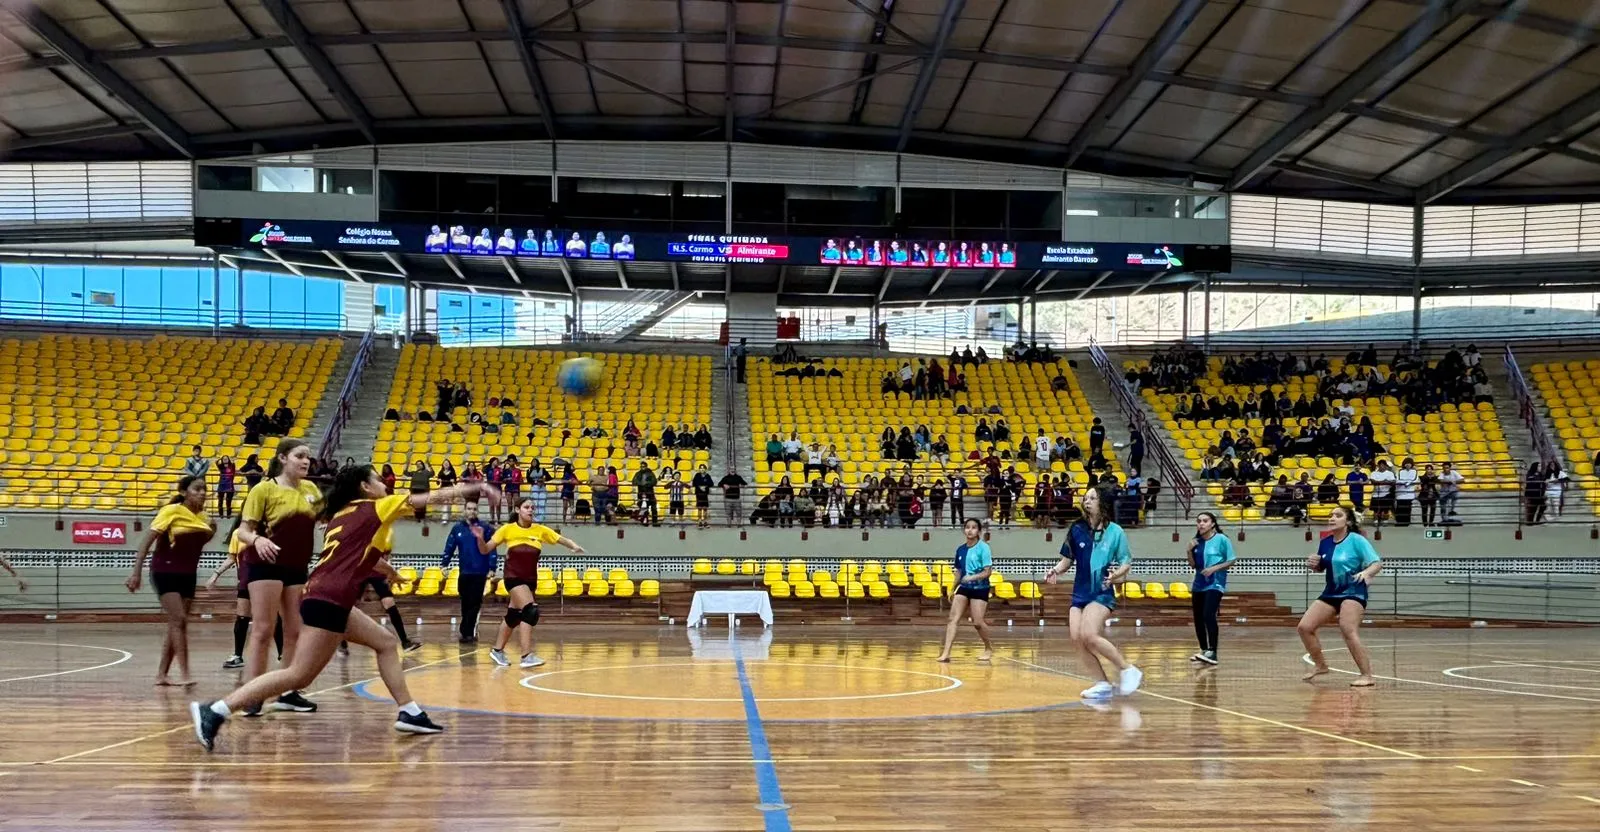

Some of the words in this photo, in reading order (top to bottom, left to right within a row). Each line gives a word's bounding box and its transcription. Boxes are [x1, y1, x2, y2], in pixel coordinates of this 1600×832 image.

[345, 228, 371, 237] Colégio
[338, 236, 367, 244] Senhora
[376, 238, 400, 246] Carmo
[719, 236, 769, 244] QUEIMADA
[672, 245, 688, 253] N.S.
[688, 245, 714, 253] Carmo
[737, 245, 777, 256] Almirante
[1067, 247, 1094, 255] Estadual
[1041, 255, 1074, 263] Almirante
[1074, 255, 1099, 263] Barroso
[101, 527, 125, 539] 5A
[314, 525, 343, 567] 5
